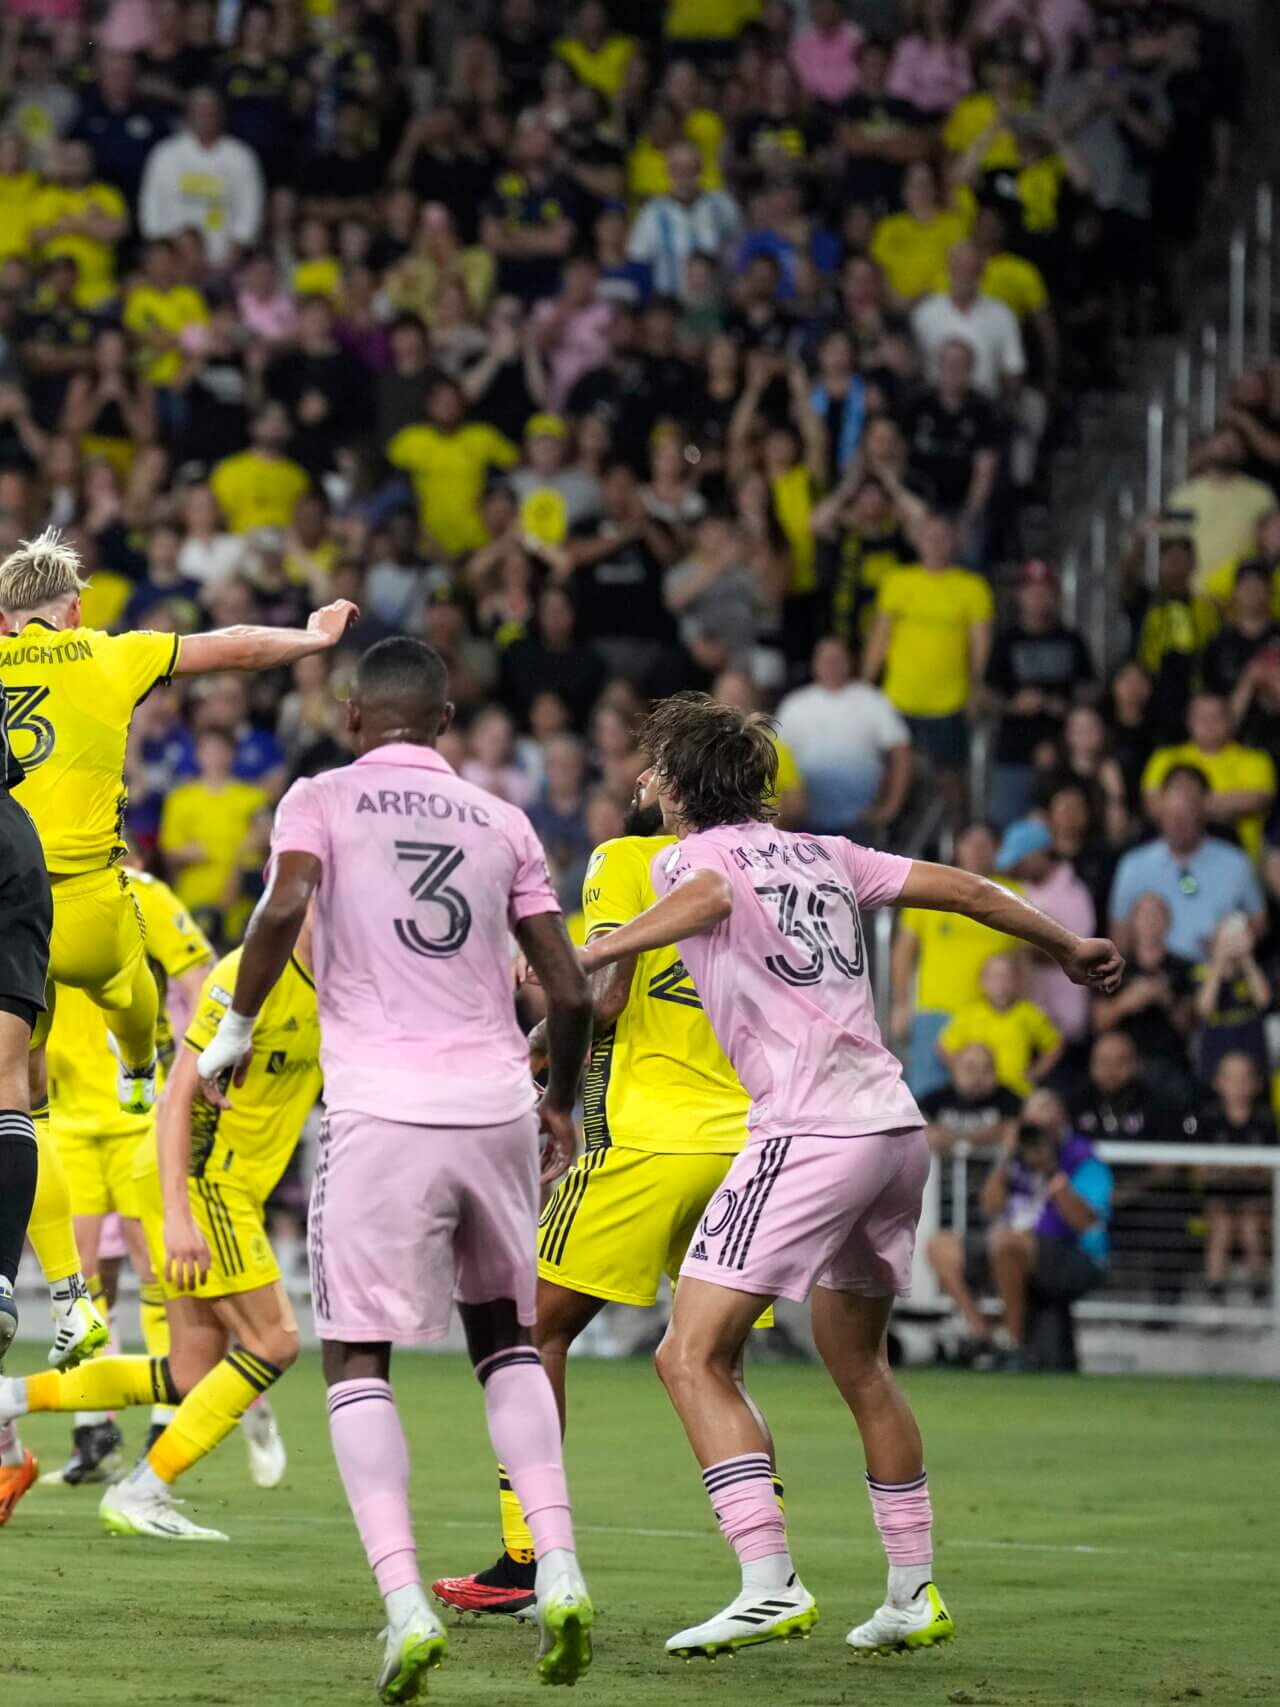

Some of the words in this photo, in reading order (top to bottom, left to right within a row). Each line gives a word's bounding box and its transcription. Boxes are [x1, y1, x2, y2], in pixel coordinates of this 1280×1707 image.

[4, 685, 56, 773] 3
[393, 840, 472, 959] 3
[754, 880, 864, 987] 30
